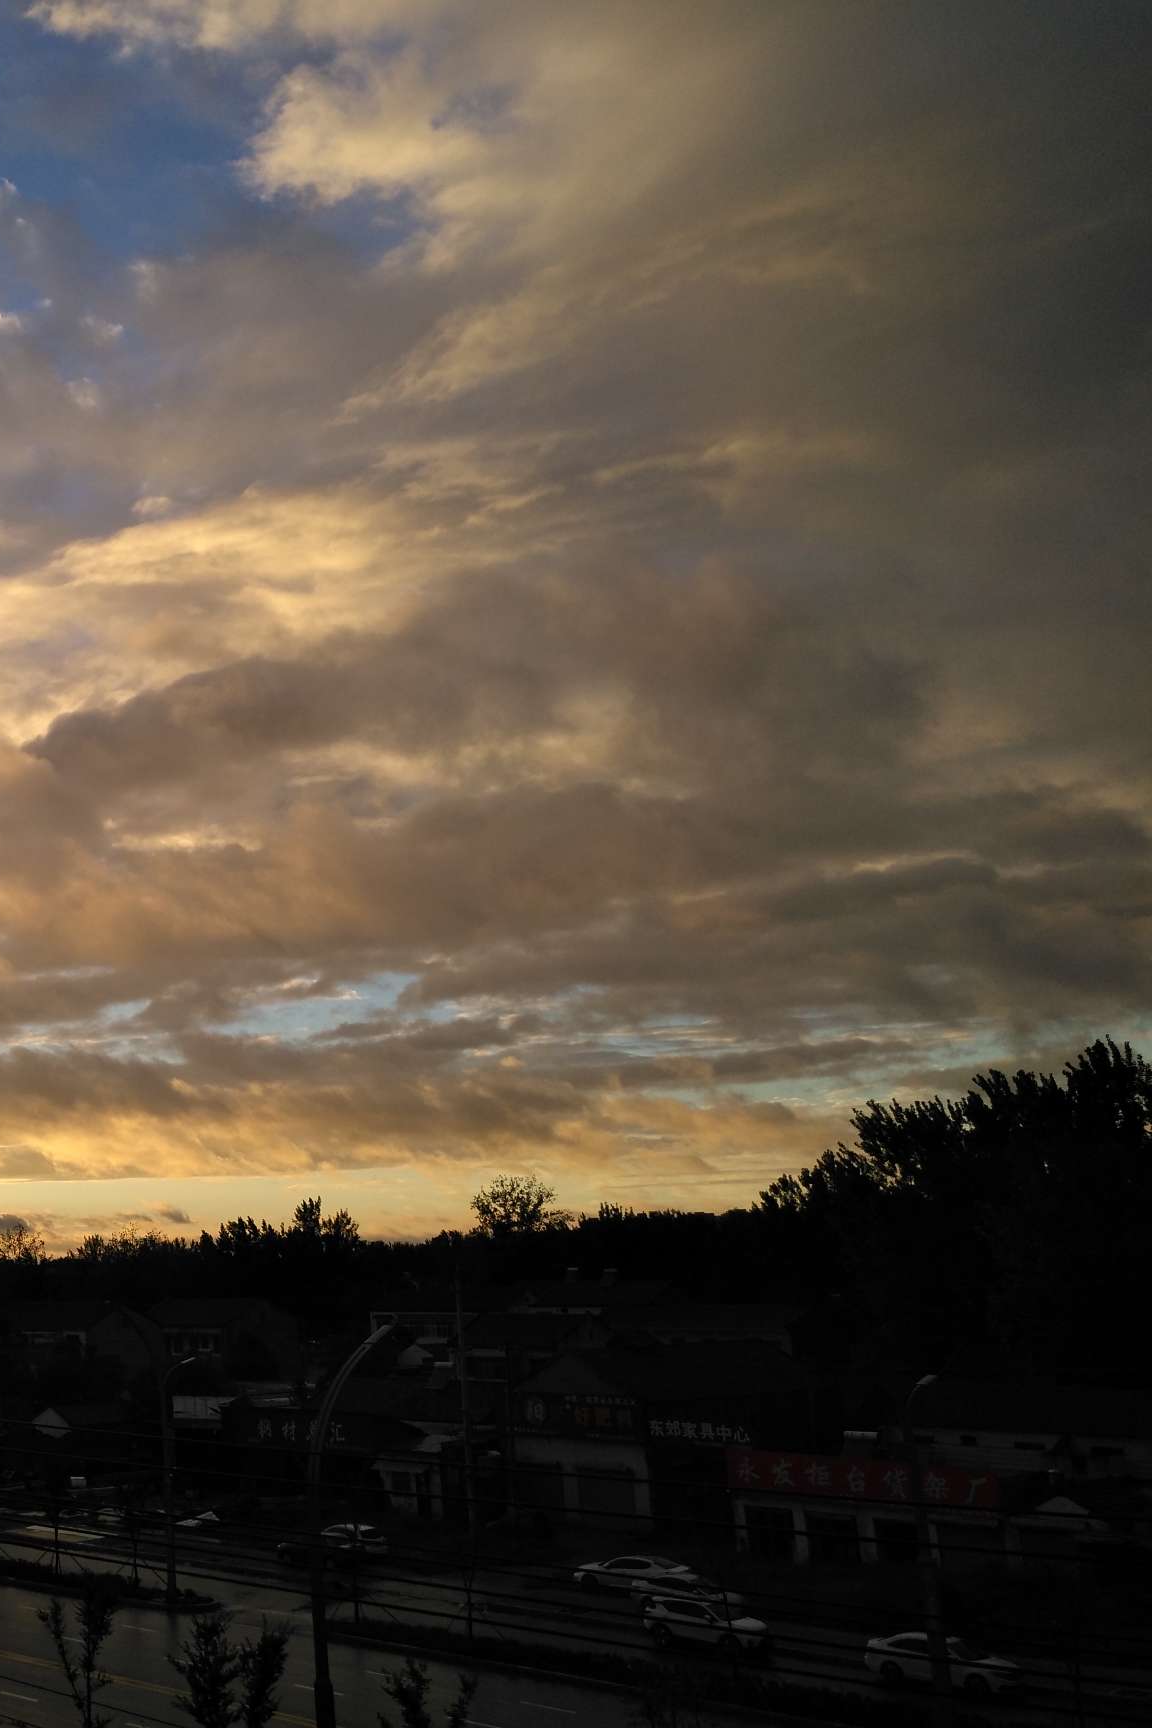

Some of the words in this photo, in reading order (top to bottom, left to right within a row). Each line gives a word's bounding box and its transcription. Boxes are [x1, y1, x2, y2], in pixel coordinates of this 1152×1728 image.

[648, 1418, 751, 1443] 东郊家具中心
[736, 1456, 992, 1504] 永发柜台货架厂
